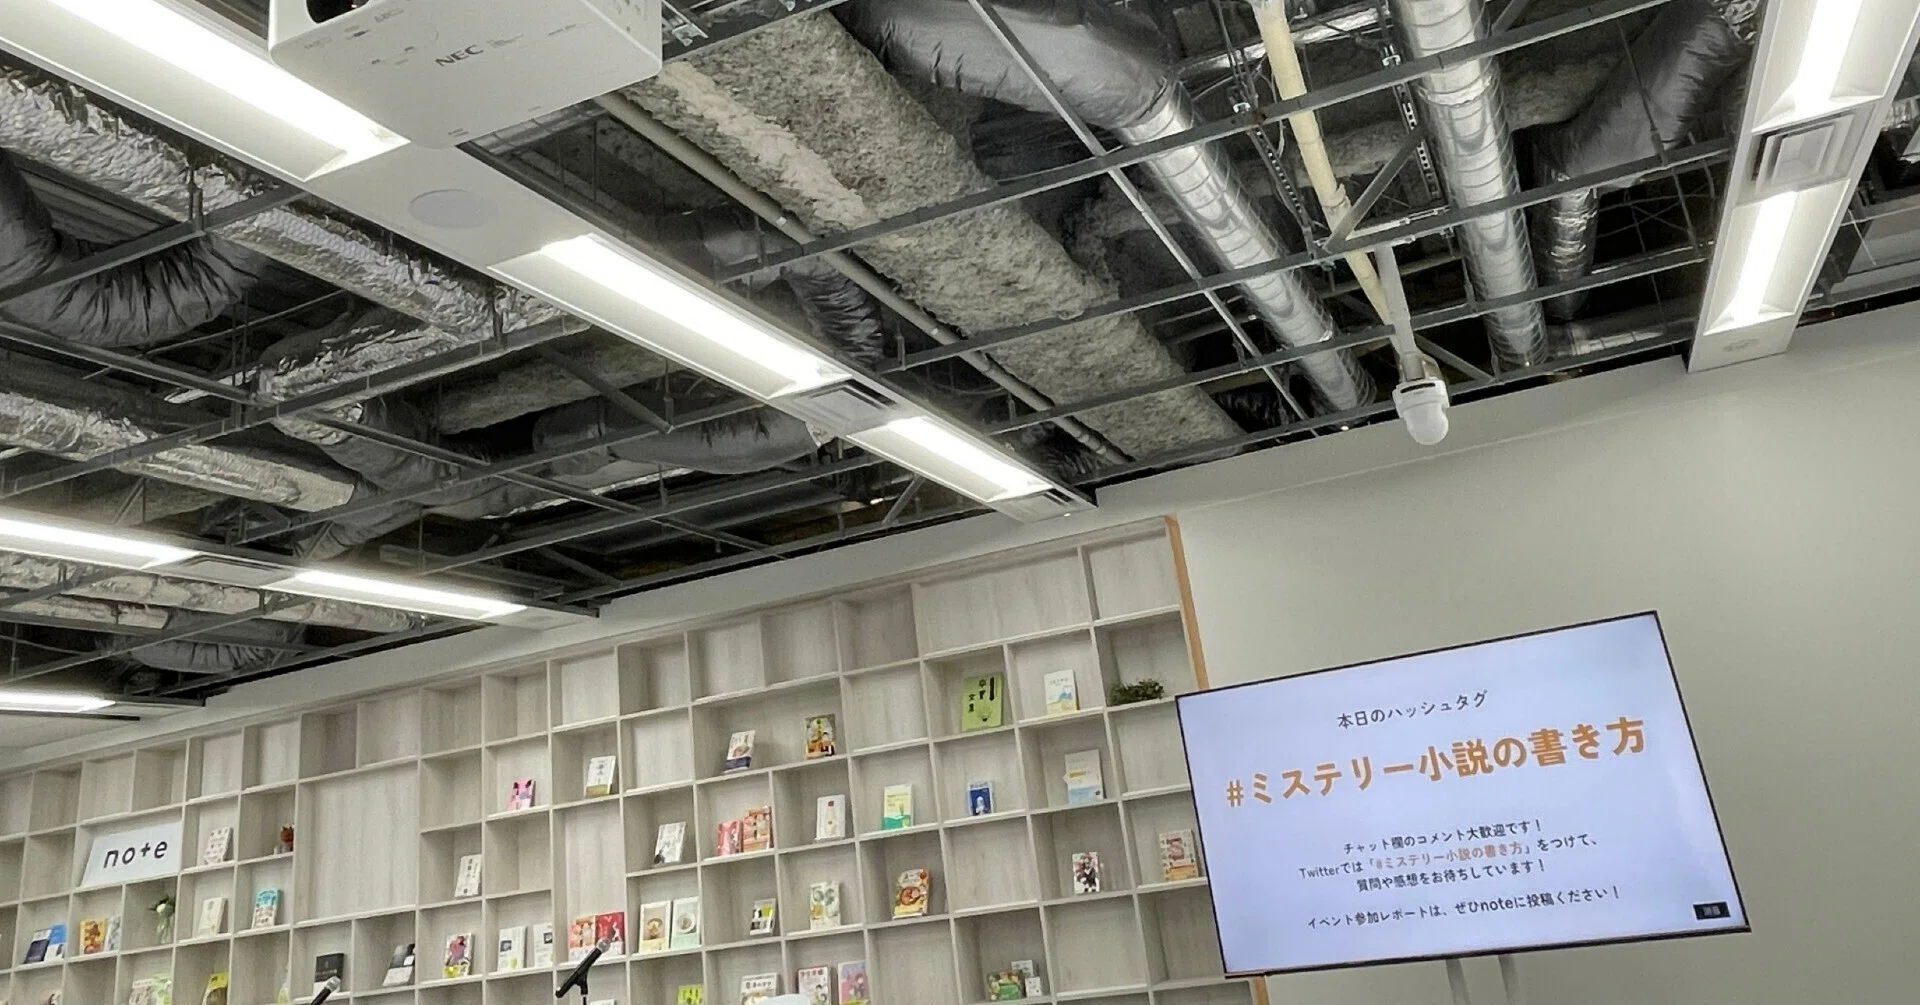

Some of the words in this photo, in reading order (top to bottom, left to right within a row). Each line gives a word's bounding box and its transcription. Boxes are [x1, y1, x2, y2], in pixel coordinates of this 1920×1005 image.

[435, 44, 484, 66] NEC
[1337, 690, 1488, 729] 本日のハッシュタグ
[1226, 716, 1646, 807] #ミステリー小説の書き方
[103, 841, 168, 868] note
